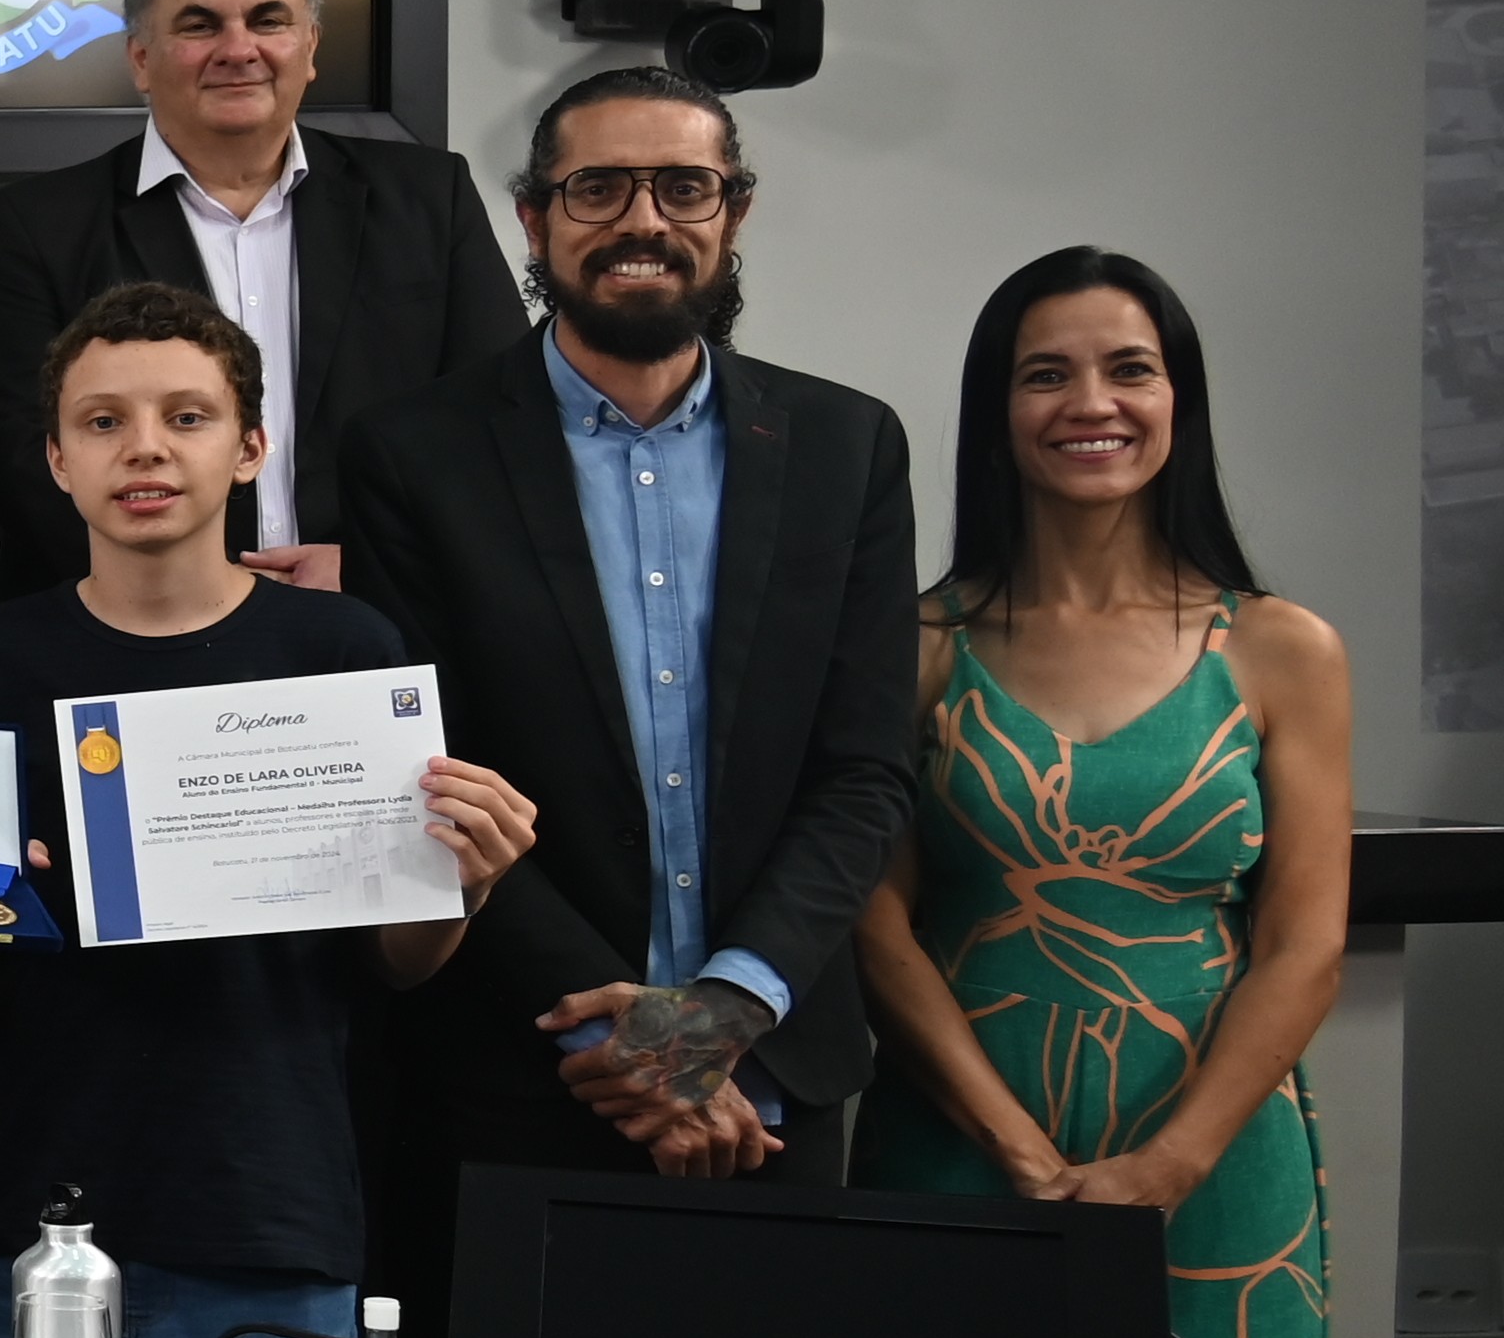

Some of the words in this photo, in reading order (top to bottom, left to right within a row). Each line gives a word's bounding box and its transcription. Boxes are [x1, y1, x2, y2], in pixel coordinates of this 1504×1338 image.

[216, 713, 308, 734] Diploma
[179, 775, 219, 788] ENZO
[224, 773, 244, 784] DE
[249, 769, 289, 782] LARA
[293, 762, 365, 777] OLIVEIRA
